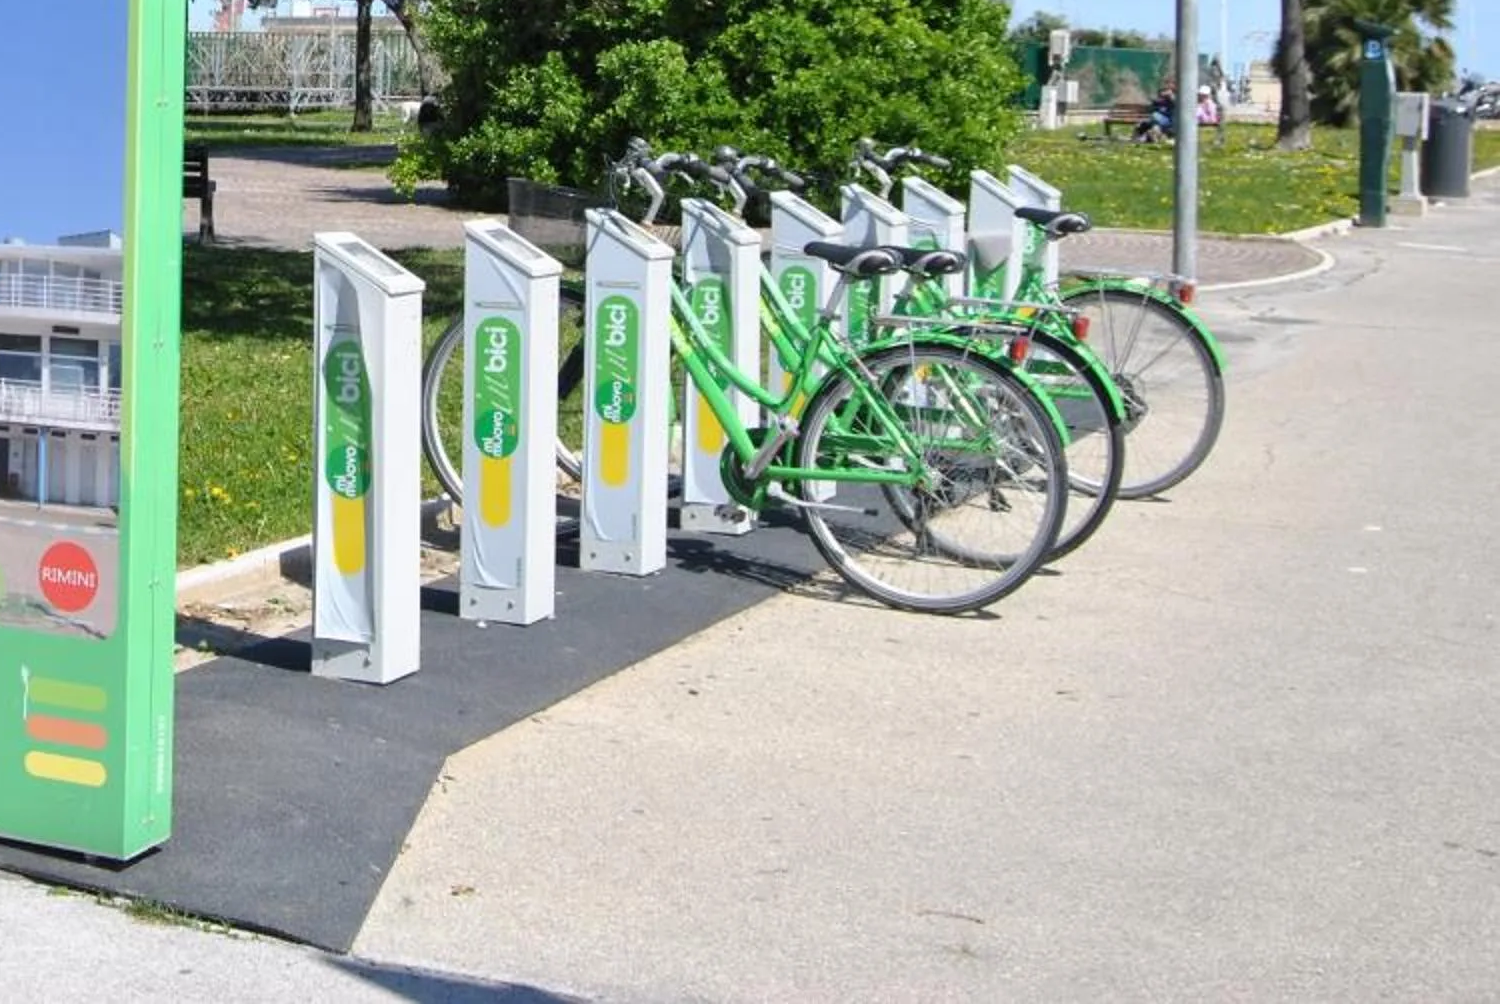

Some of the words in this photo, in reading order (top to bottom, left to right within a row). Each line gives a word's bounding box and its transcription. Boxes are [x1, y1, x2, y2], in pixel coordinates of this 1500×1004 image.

[700, 287, 720, 325] bici
[787, 273, 806, 309] bici
[604, 304, 627, 347] bici
[484, 326, 508, 373] bici
[336, 351, 361, 404] bici
[42, 566, 95, 589] RIMINI
